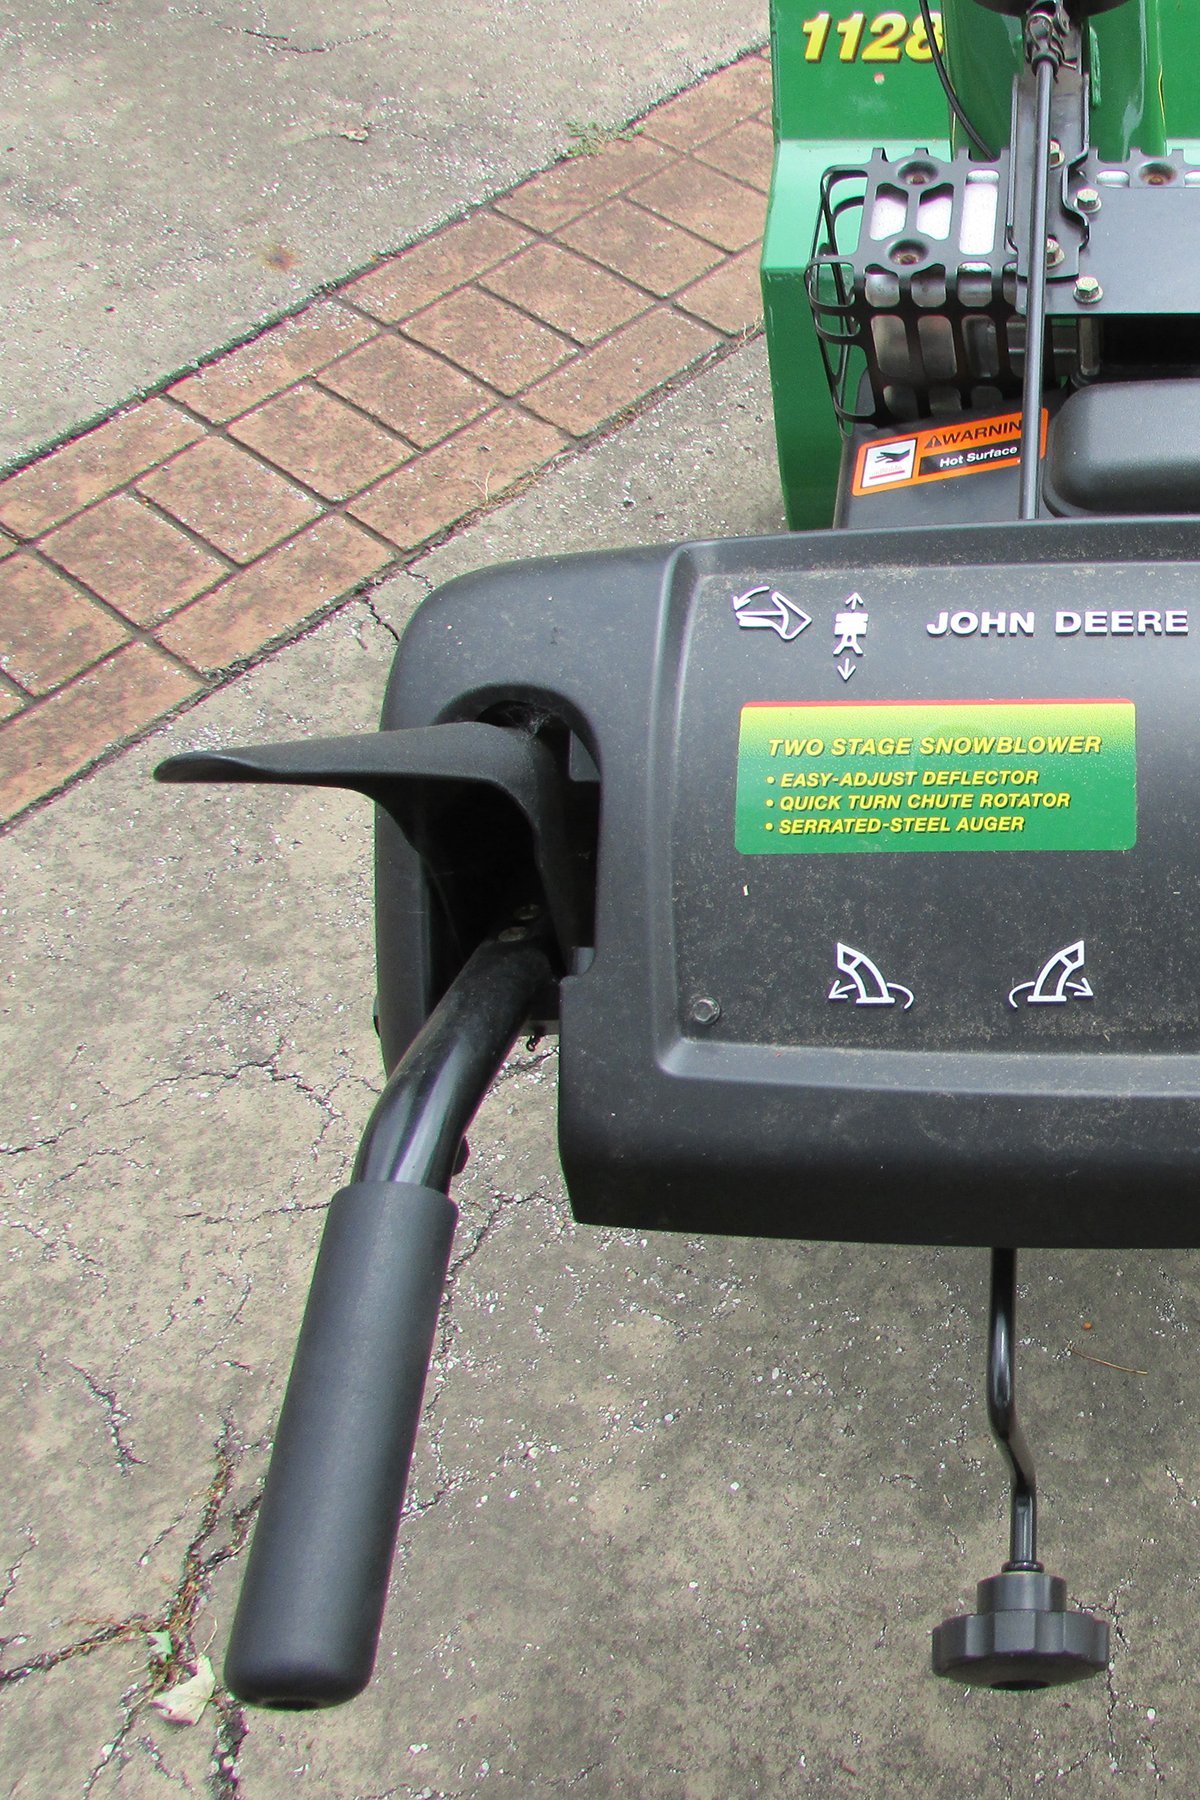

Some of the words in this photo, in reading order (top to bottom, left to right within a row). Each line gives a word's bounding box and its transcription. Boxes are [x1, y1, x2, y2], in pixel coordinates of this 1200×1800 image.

[802, 11, 944, 63] 1128
[942, 420, 1022, 446] WARNIN
[939, 455, 964, 468] Hot
[968, 446, 1018, 464] Surface
[926, 611, 1035, 636] JOHN
[1055, 610, 1189, 635] DEERE
[768, 738, 823, 757] TWO
[830, 736, 912, 756] STAGE
[919, 735, 1102, 755] SNOWBLOWER
[780, 771, 917, 789] EASY-ADJUST
[922, 769, 1039, 787] DEFLECTOR
[779, 796, 841, 812] QUICK
[848, 795, 900, 810] TURN
[906, 793, 973, 810] CHUTE
[980, 792, 1071, 809] ROTATOR
[778, 818, 951, 835] SERRATED-STEEL
[955, 816, 1025, 833] AUGER
